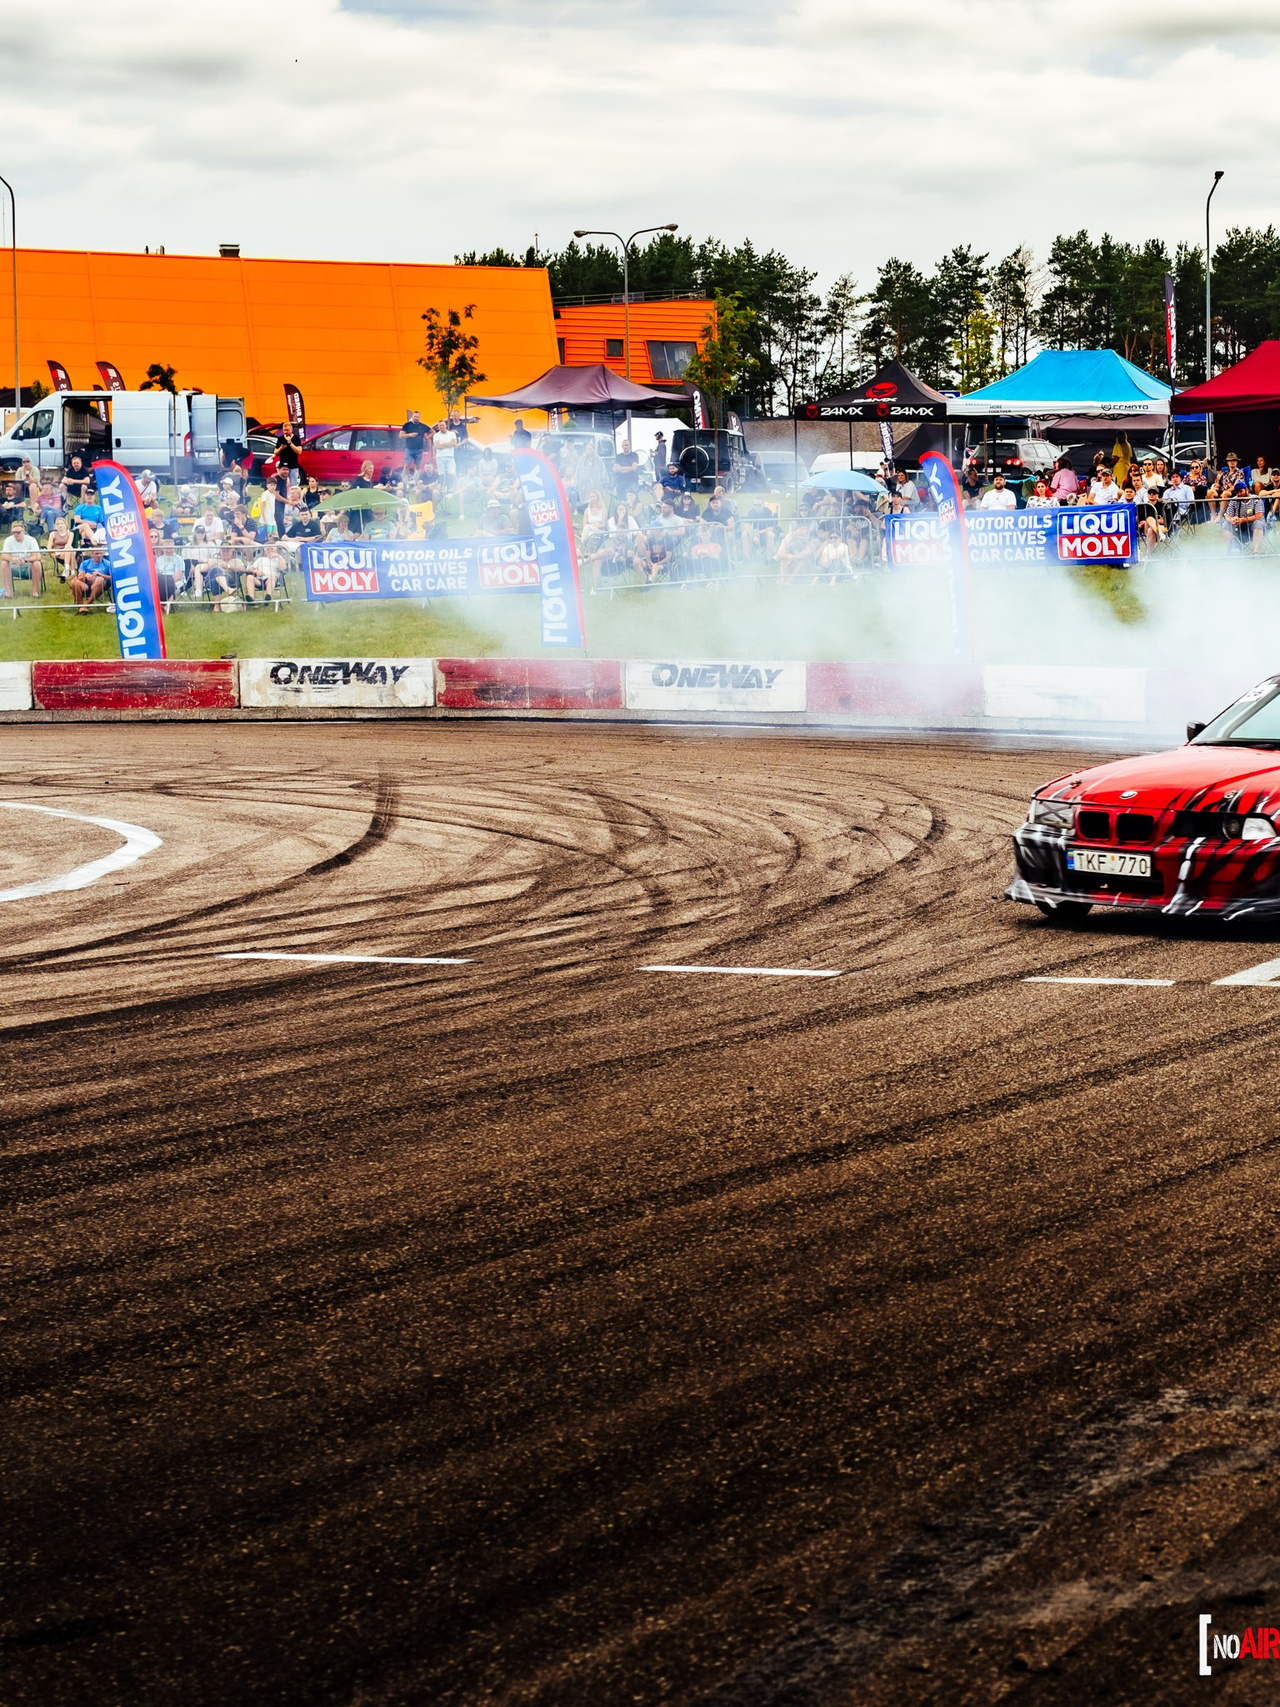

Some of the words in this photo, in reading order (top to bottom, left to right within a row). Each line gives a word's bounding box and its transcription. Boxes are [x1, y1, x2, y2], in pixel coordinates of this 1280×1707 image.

[820, 406, 864, 416] 24MX
[890, 407, 934, 416] 24MX
[964, 516, 1015, 532] MOTOR
[1017, 514, 1053, 529] OILS
[1061, 512, 1125, 535] LIQUI
[967, 531, 1047, 547] ADDITIVES
[1061, 535, 1129, 557] MOLY
[312, 549, 373, 571] LIQUI
[381, 549, 438, 562] MOTOR
[441, 548, 473, 560] OILS
[481, 542, 537, 564] LIQU
[970, 548, 1001, 562] CAR
[1003, 547, 1046, 561] CARE
[388, 561, 468, 577] ADDITIVES
[314, 570, 376, 592] MOLY
[391, 577, 423, 592] CAR
[425, 577, 468, 591] CARE
[1076, 852, 1107, 871] TKF
[1118, 855, 1148, 875] 770
